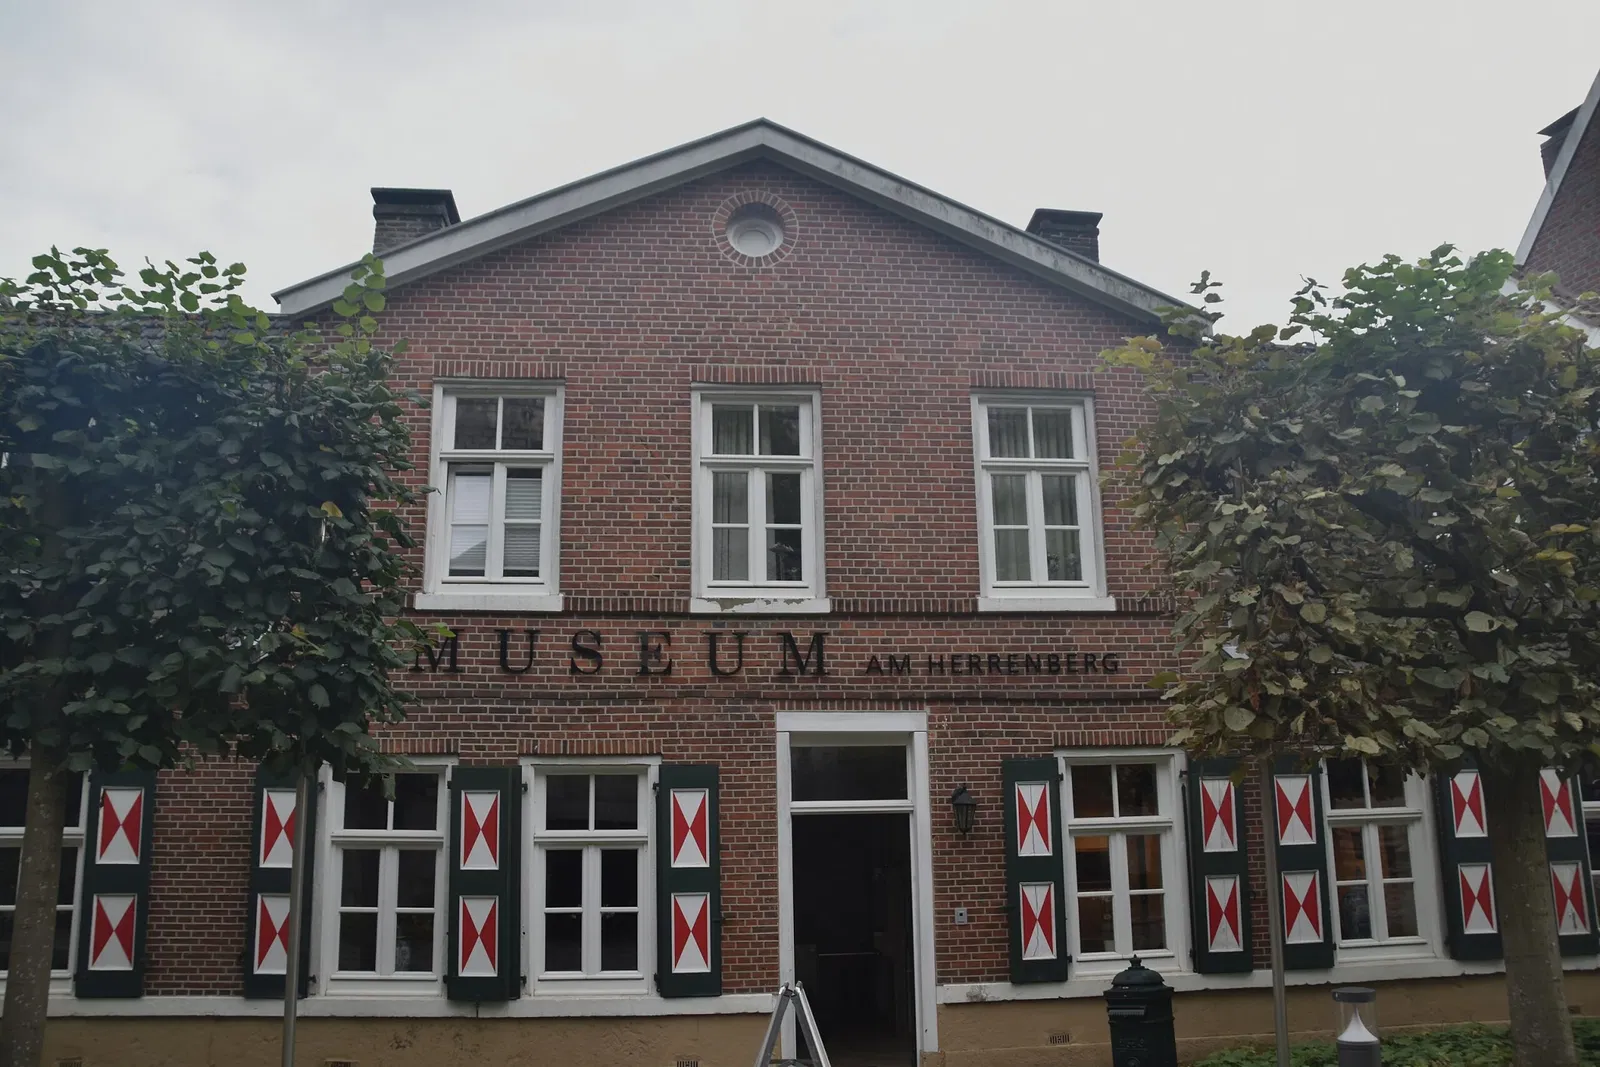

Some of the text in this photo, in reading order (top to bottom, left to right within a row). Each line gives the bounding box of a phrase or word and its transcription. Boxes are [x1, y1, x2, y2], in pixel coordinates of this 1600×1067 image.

[409, 628, 1120, 675] MUSEUM AM HERRENBERG
